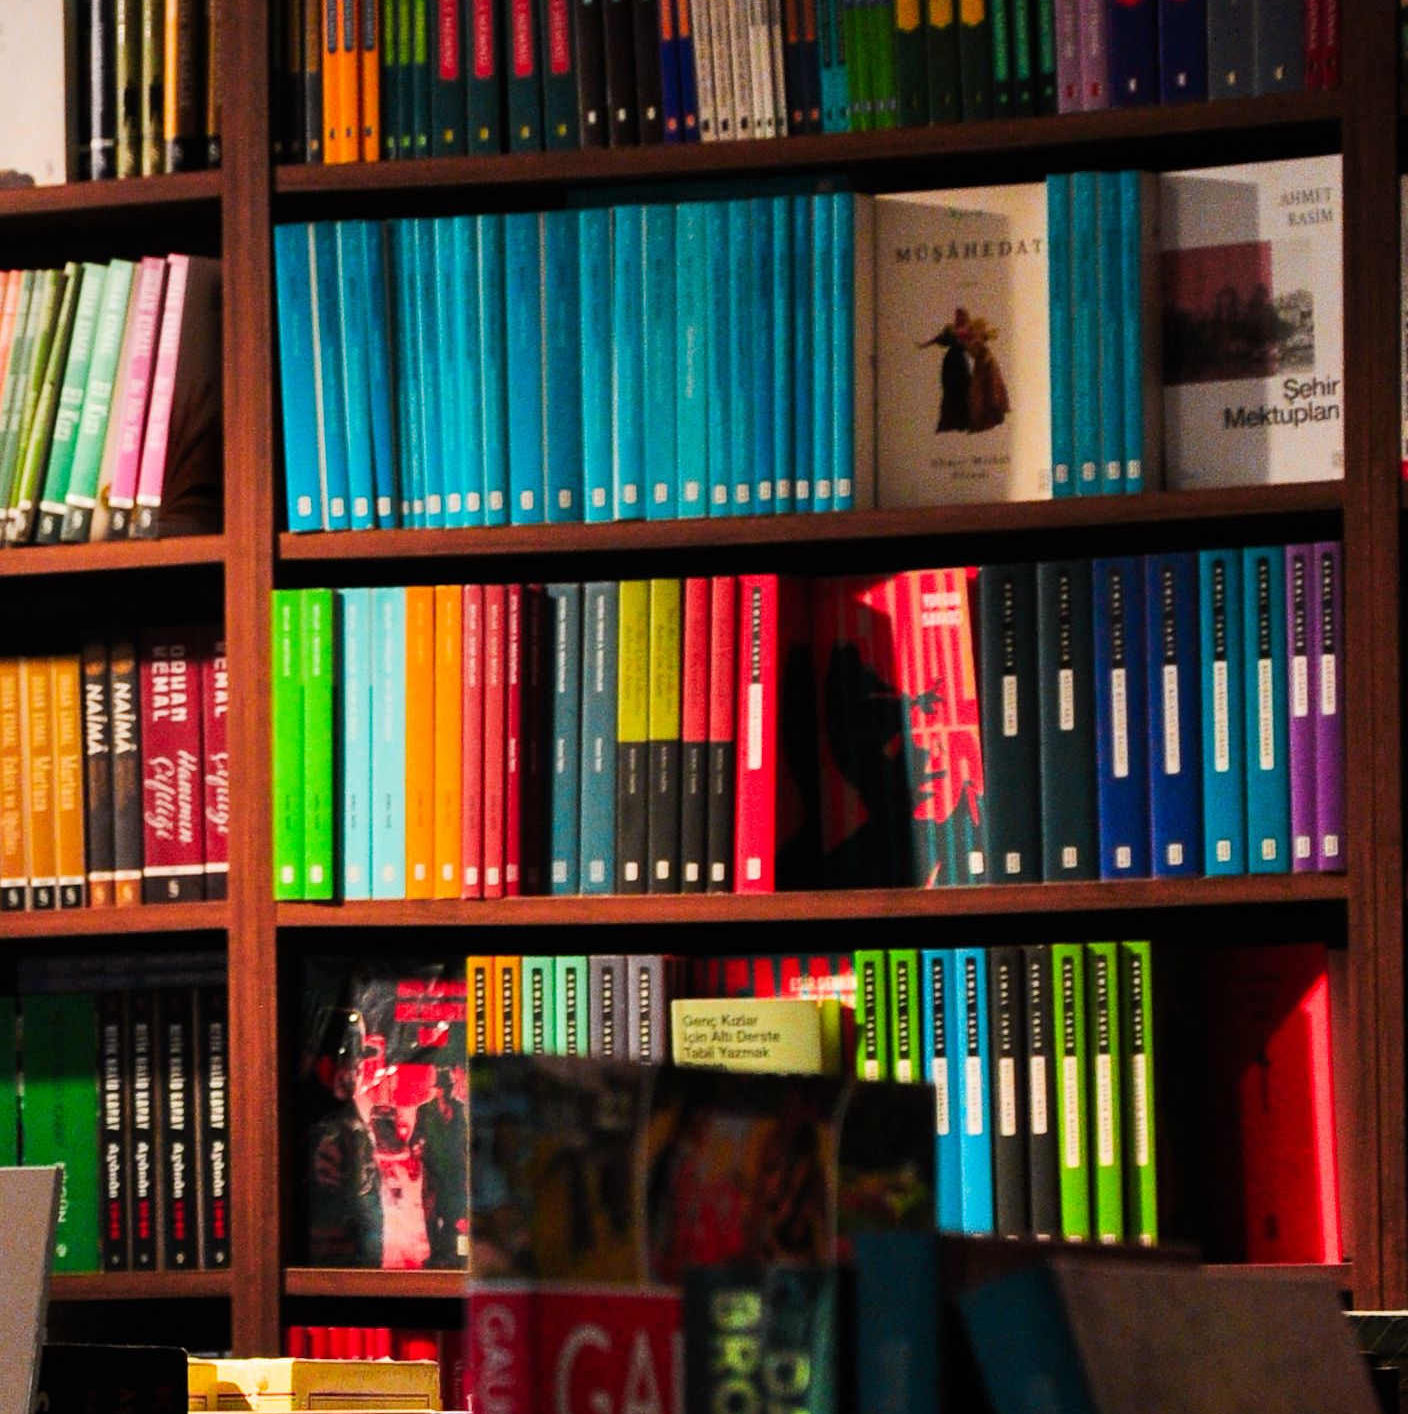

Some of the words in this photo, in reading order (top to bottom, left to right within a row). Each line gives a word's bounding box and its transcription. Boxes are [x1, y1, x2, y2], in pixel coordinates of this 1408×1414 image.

[1283, 377, 1339, 404] Şehir
[1223, 403, 1340, 430] Mektupları
[682, 1014, 717, 1029] Genç
[722, 1014, 758, 1027] Kızlar
[737, 1030, 781, 1043] Derste
[719, 1046, 769, 1059] Yazmak
